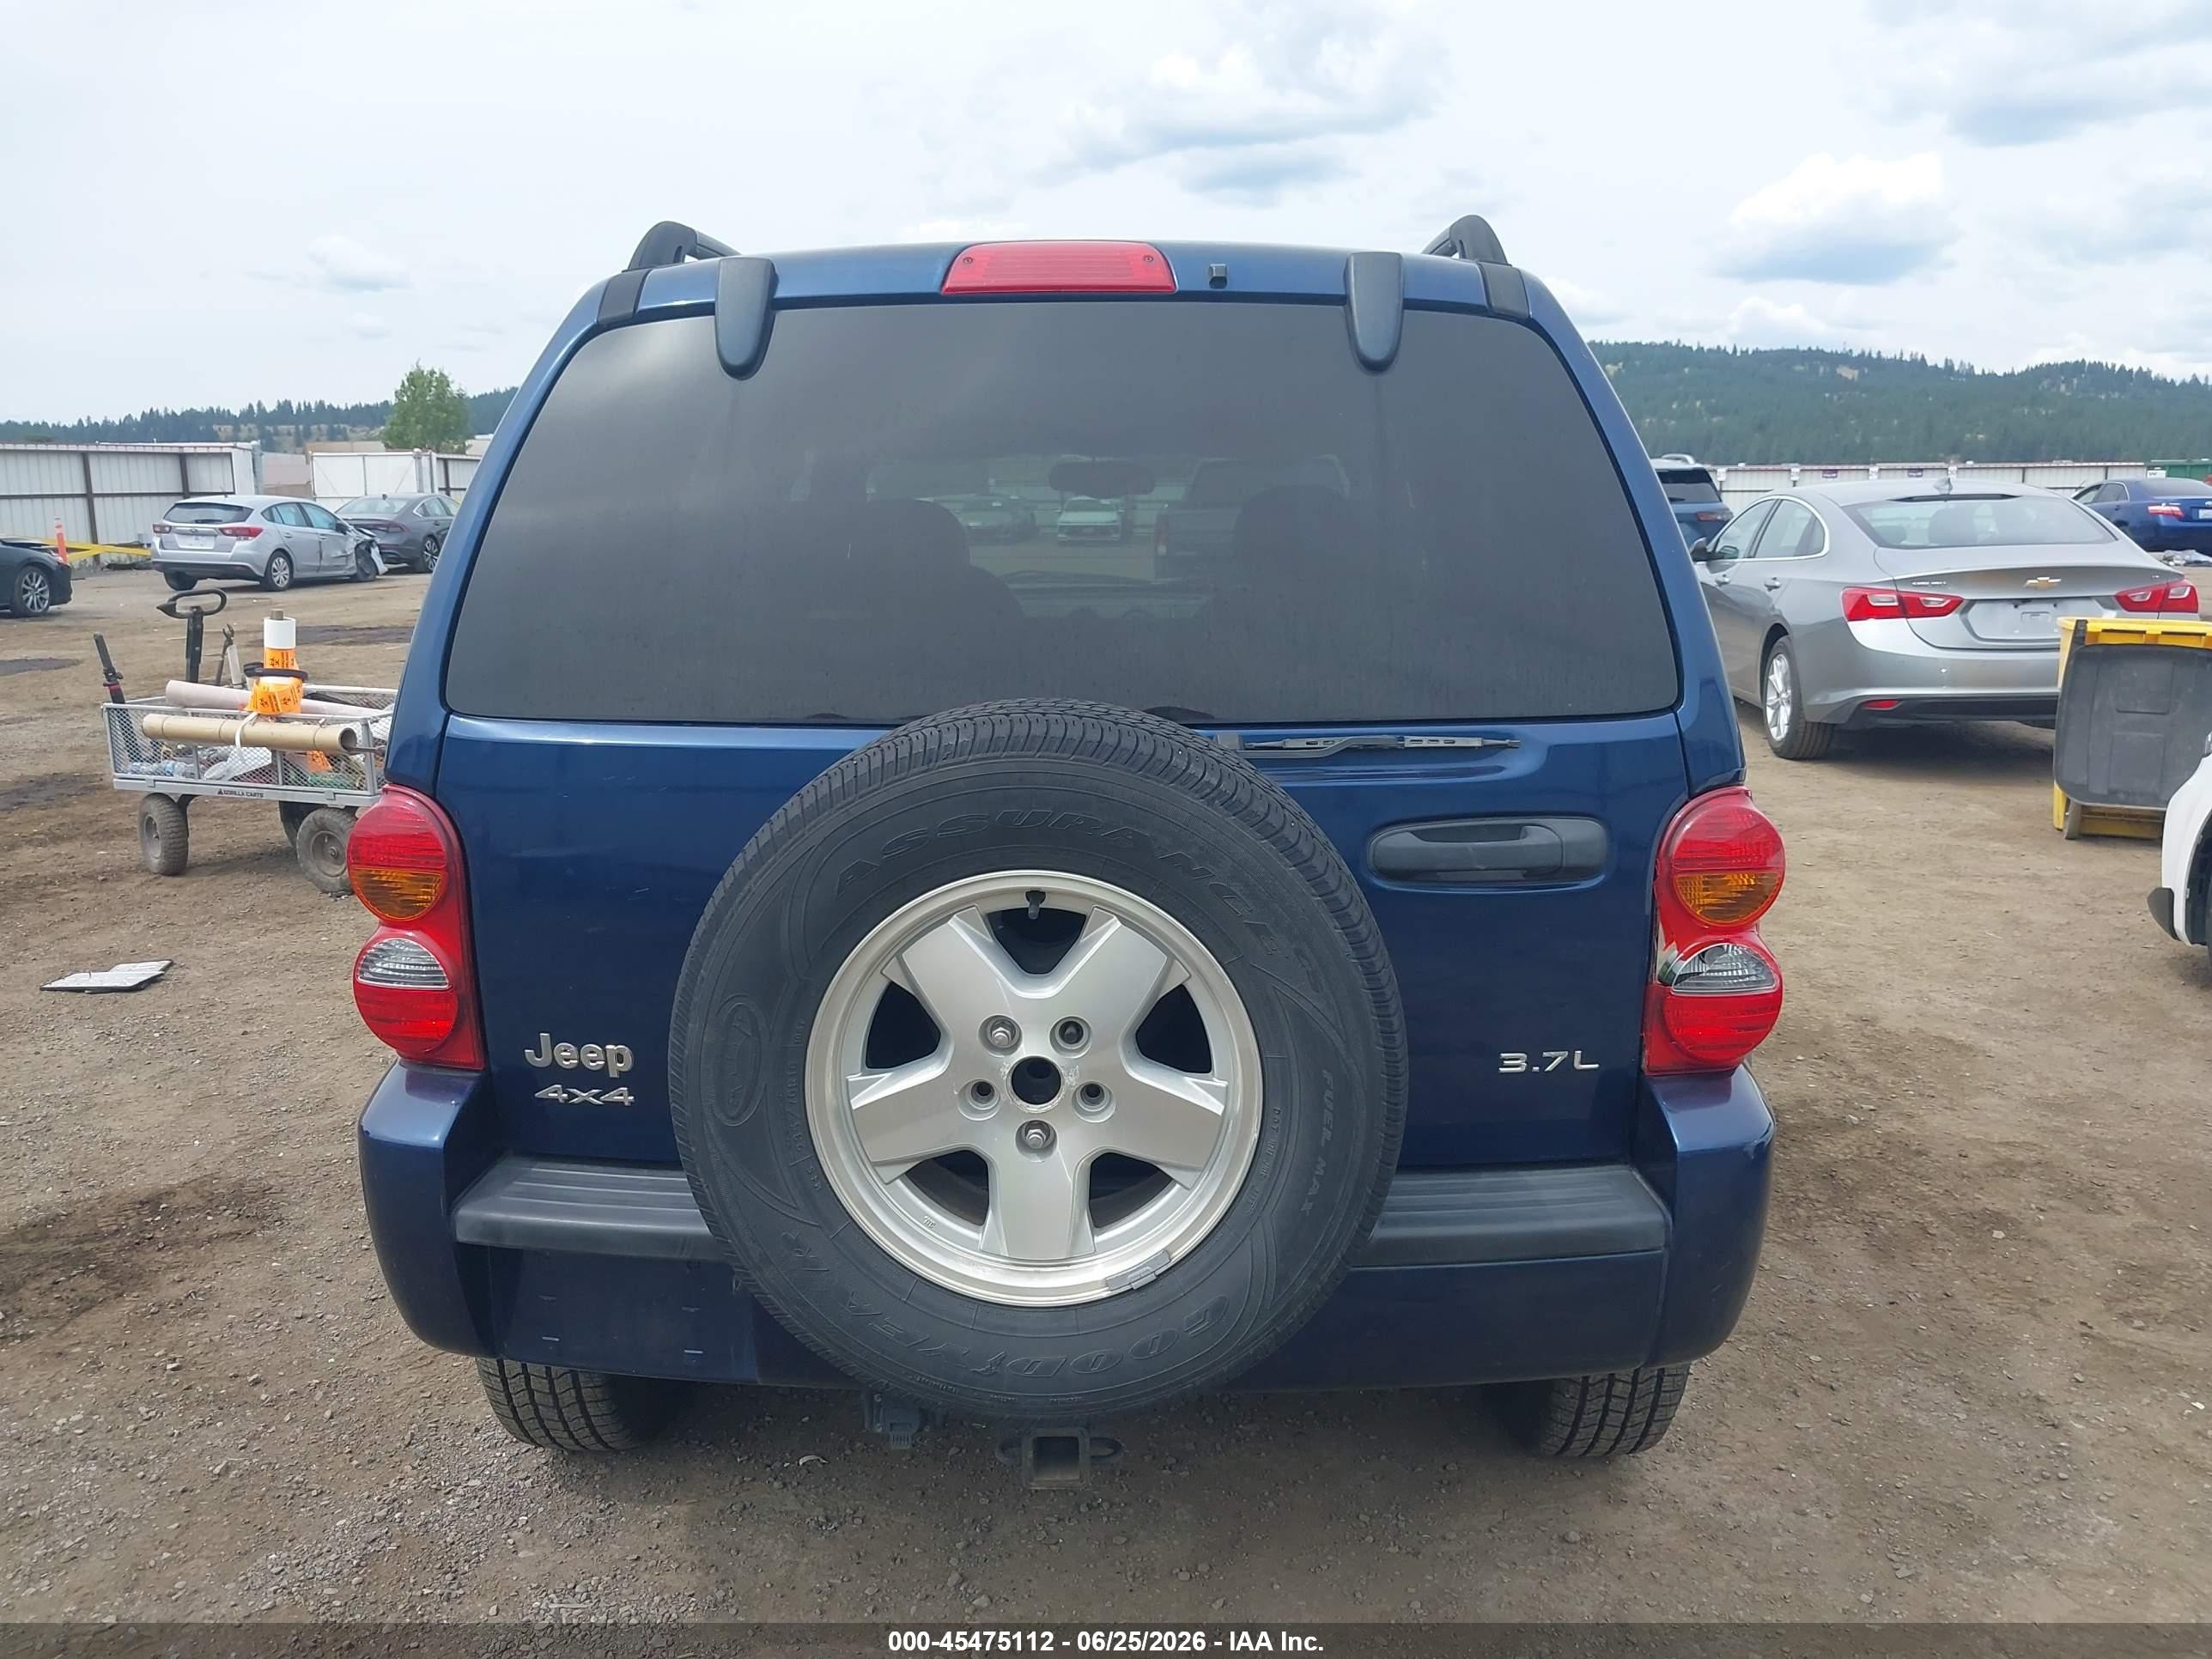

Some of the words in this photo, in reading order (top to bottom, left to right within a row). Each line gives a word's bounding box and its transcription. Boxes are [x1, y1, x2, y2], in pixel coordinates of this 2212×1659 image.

[833, 809, 1291, 957] ASSURANCE
[524, 1032, 634, 1079] Jeep
[1498, 1049, 1601, 1073] 3.7L
[1321, 1068, 1335, 1148] FUEL
[1301, 1156, 1328, 1217] MAX
[790, 1231, 1230, 1378] GOODYEAR
